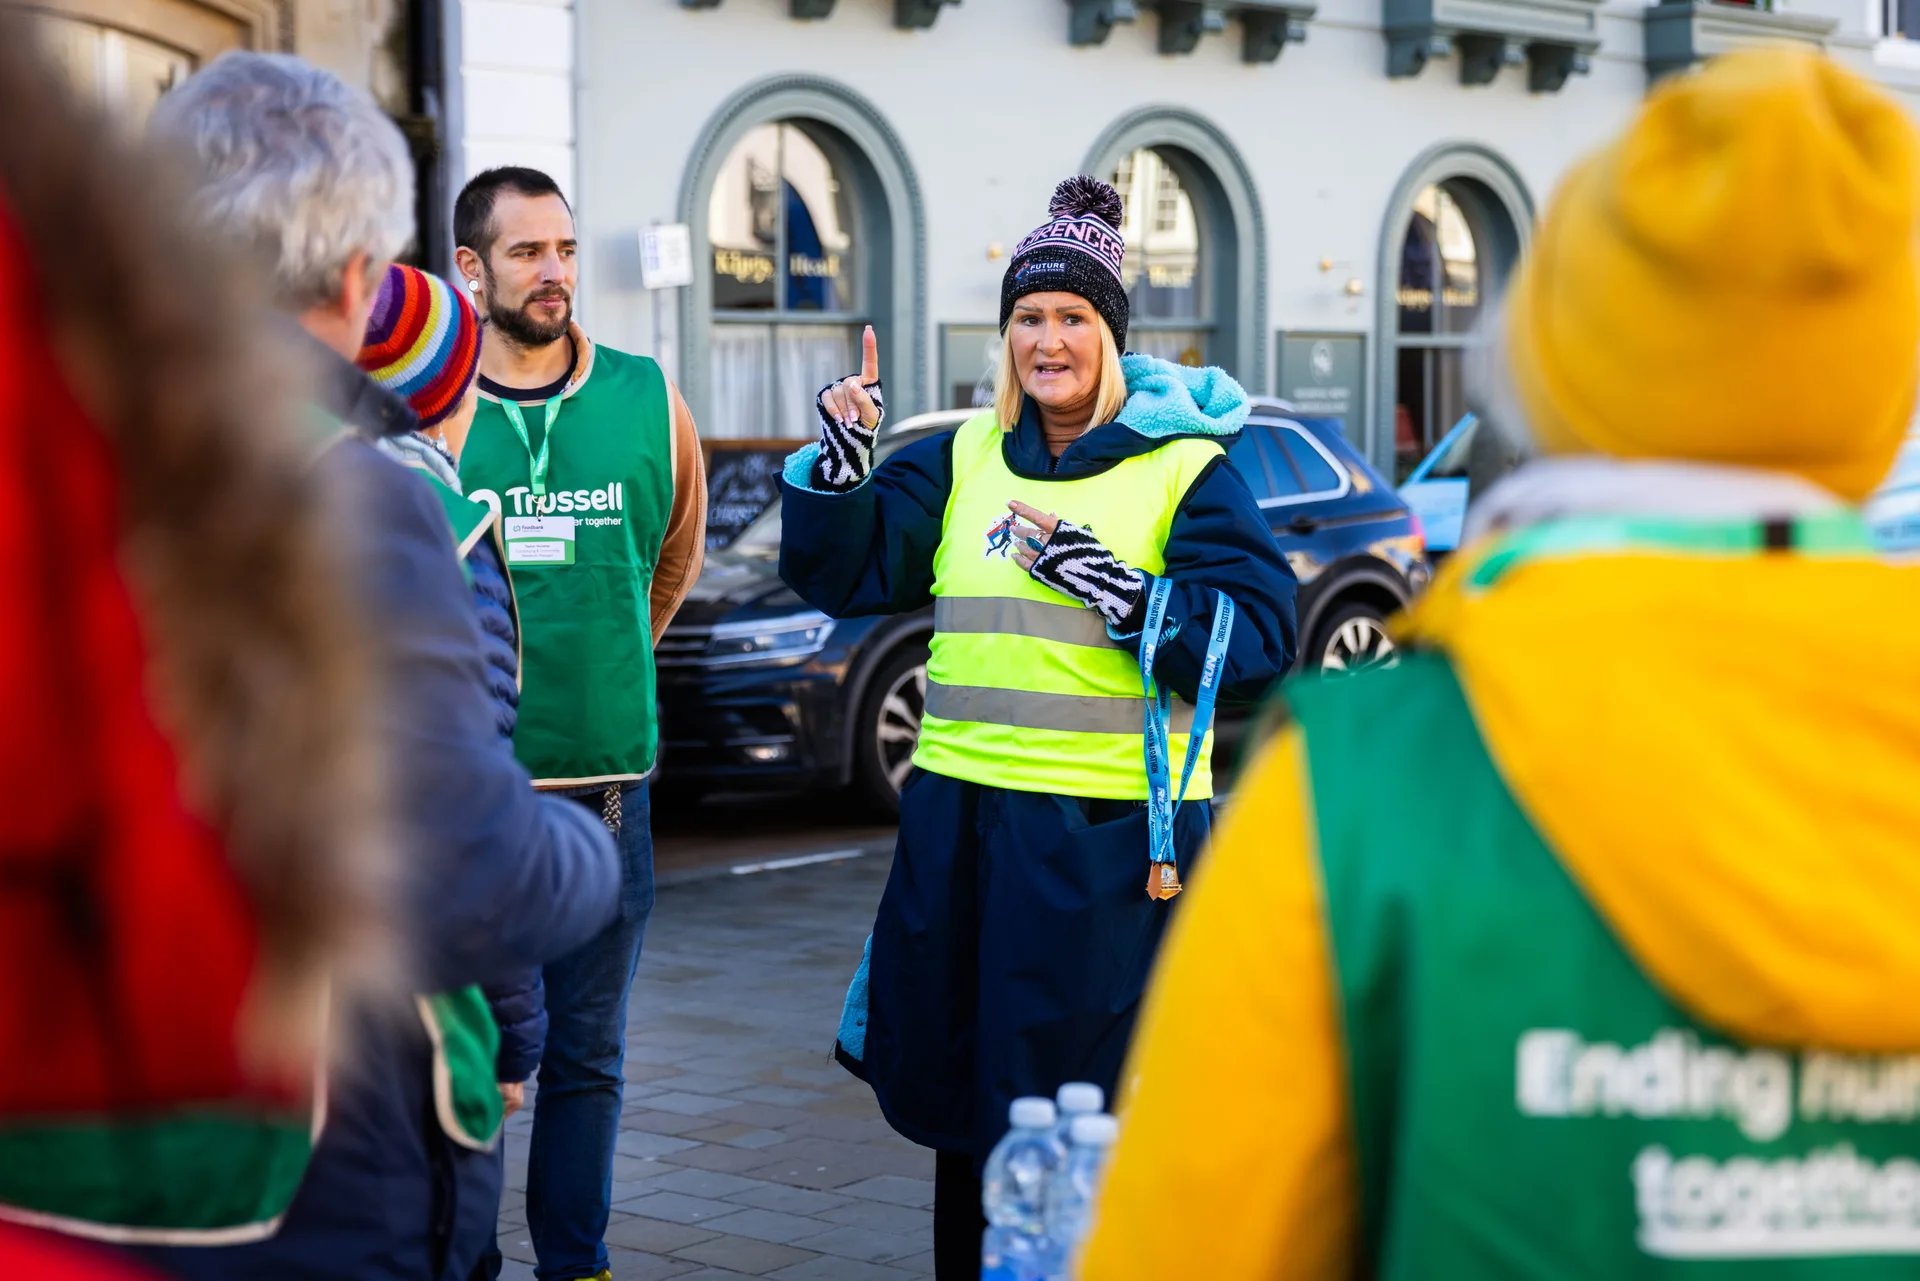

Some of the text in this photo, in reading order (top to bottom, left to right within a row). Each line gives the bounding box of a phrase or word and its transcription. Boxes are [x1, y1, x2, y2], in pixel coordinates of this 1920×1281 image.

[1030, 262, 1065, 271] FUTURE
[505, 482, 622, 515] Trussell
[585, 516, 622, 528] together
[1148, 596, 1163, 630] MARATHON
[1216, 606, 1230, 643] CIRENCESTER
[1144, 643, 1155, 677] RUN
[1201, 654, 1218, 688] RUN
[1147, 741, 1159, 774] MARATHON
[1186, 735, 1200, 767] MARATHON
[1516, 1027, 1793, 1142] Ending
